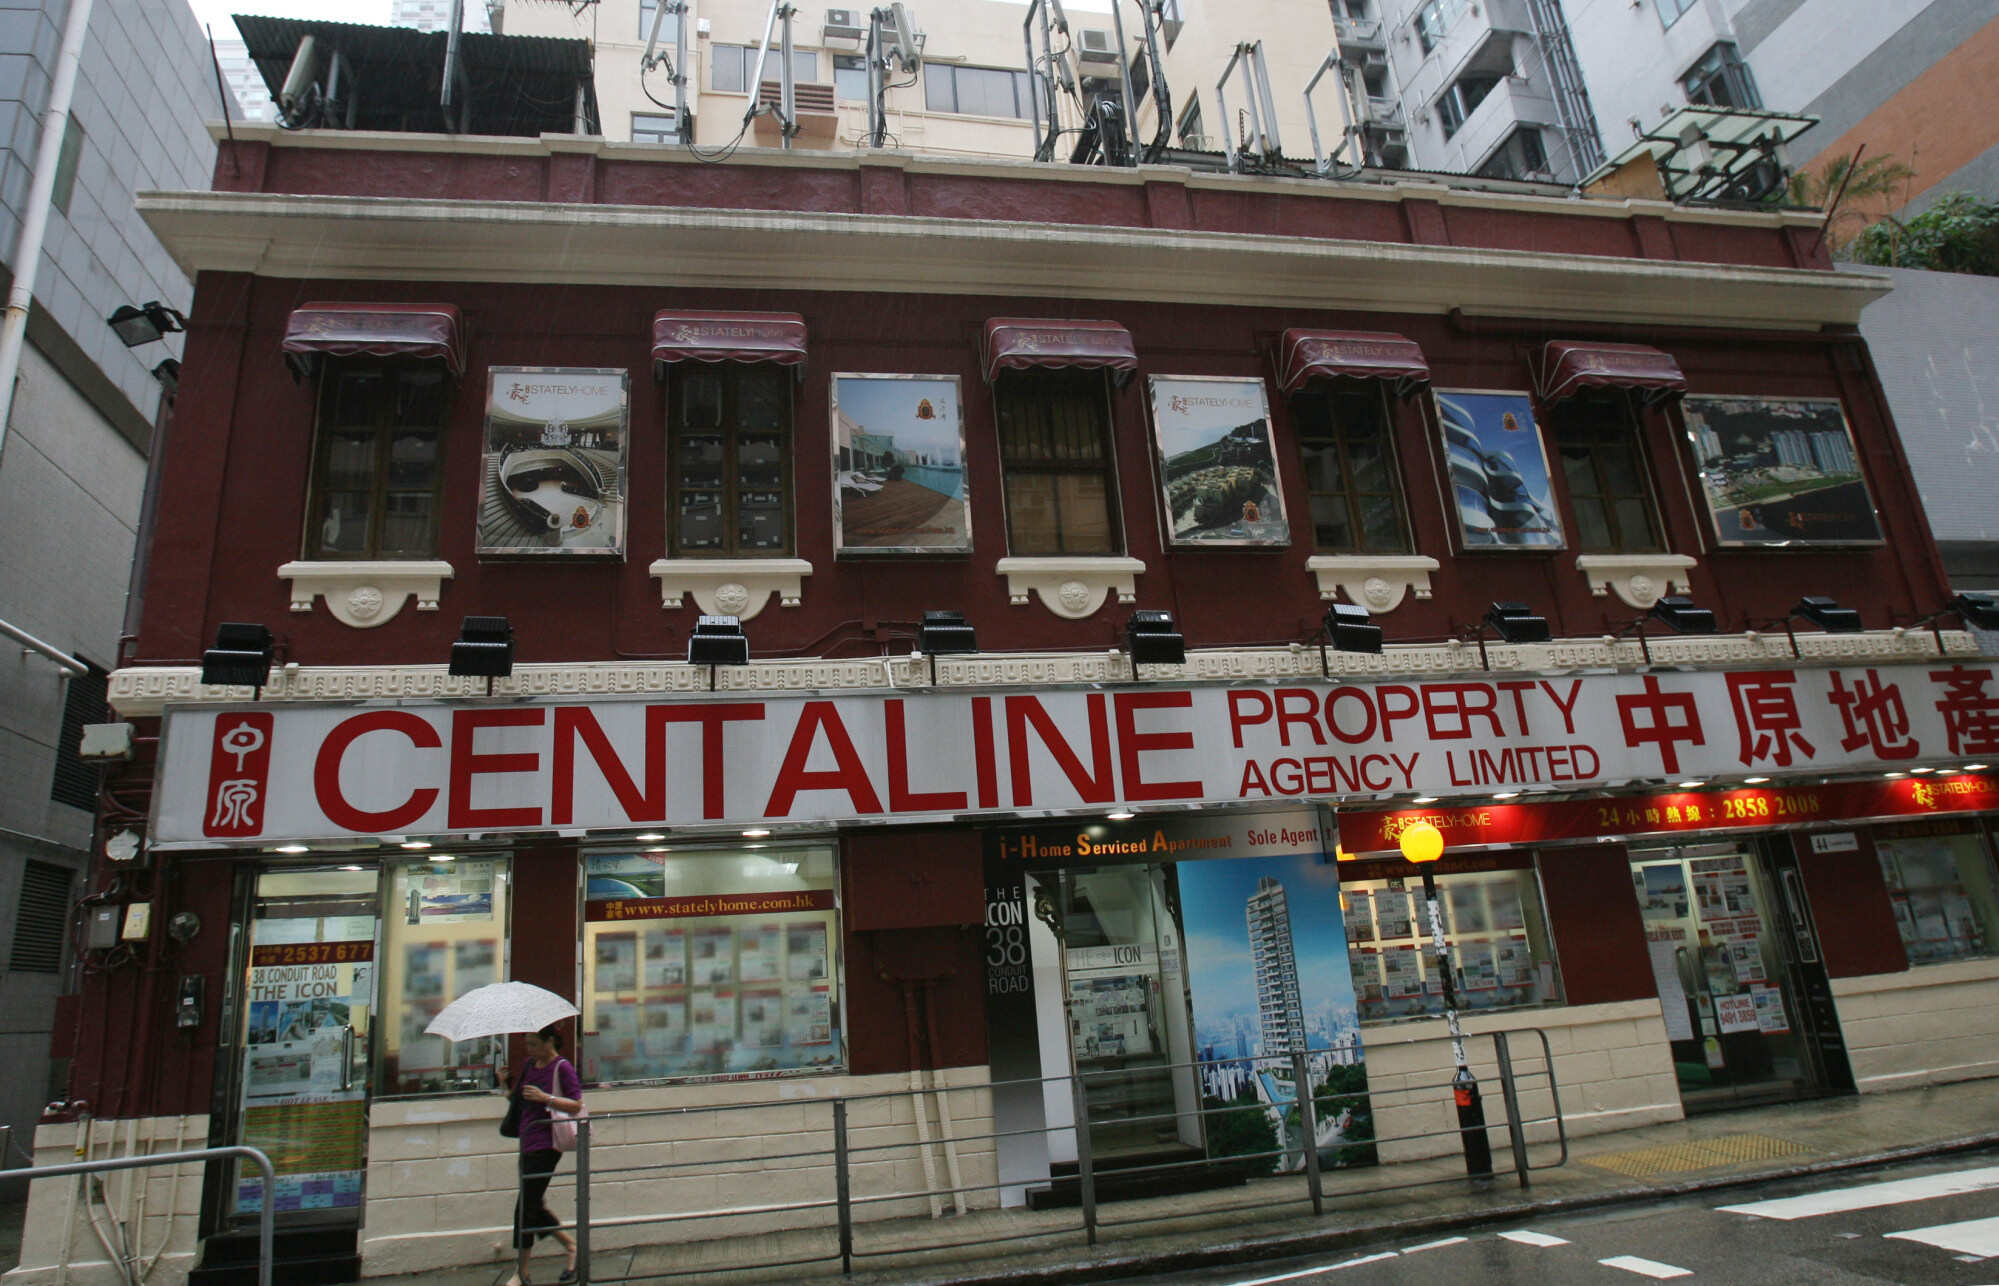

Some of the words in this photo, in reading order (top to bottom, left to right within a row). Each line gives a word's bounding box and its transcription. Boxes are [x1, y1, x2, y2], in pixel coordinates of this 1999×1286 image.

[1226, 678, 1583, 749] PROPERTY
[1615, 664, 1999, 775] 中原地產
[313, 689, 1205, 833] CENTALINE
[1238, 752, 1420, 798] AGENCY
[1445, 743, 1601, 788] LIMITED
[1722, 797, 1769, 820] 2858
[1774, 794, 1819, 816] 2008
[1076, 833, 1148, 857] Serviced
[1152, 828, 1233, 853] Apartment
[1247, 829, 1278, 847] Sole
[1281, 828, 1318, 845] Agent
[624, 894, 815, 917] www.statelyhome.com.hk
[283, 946, 332, 964] 2537
[986, 926, 1026, 967] 38
[1113, 945, 1142, 965] ICON
[253, 970, 265, 984] 38
[267, 966, 310, 983] CONDUIT
[312, 965, 338, 980] ROAD
[988, 976, 1029, 994] ROAD
[252, 984, 288, 1001] THE
[295, 981, 338, 998] ICON
